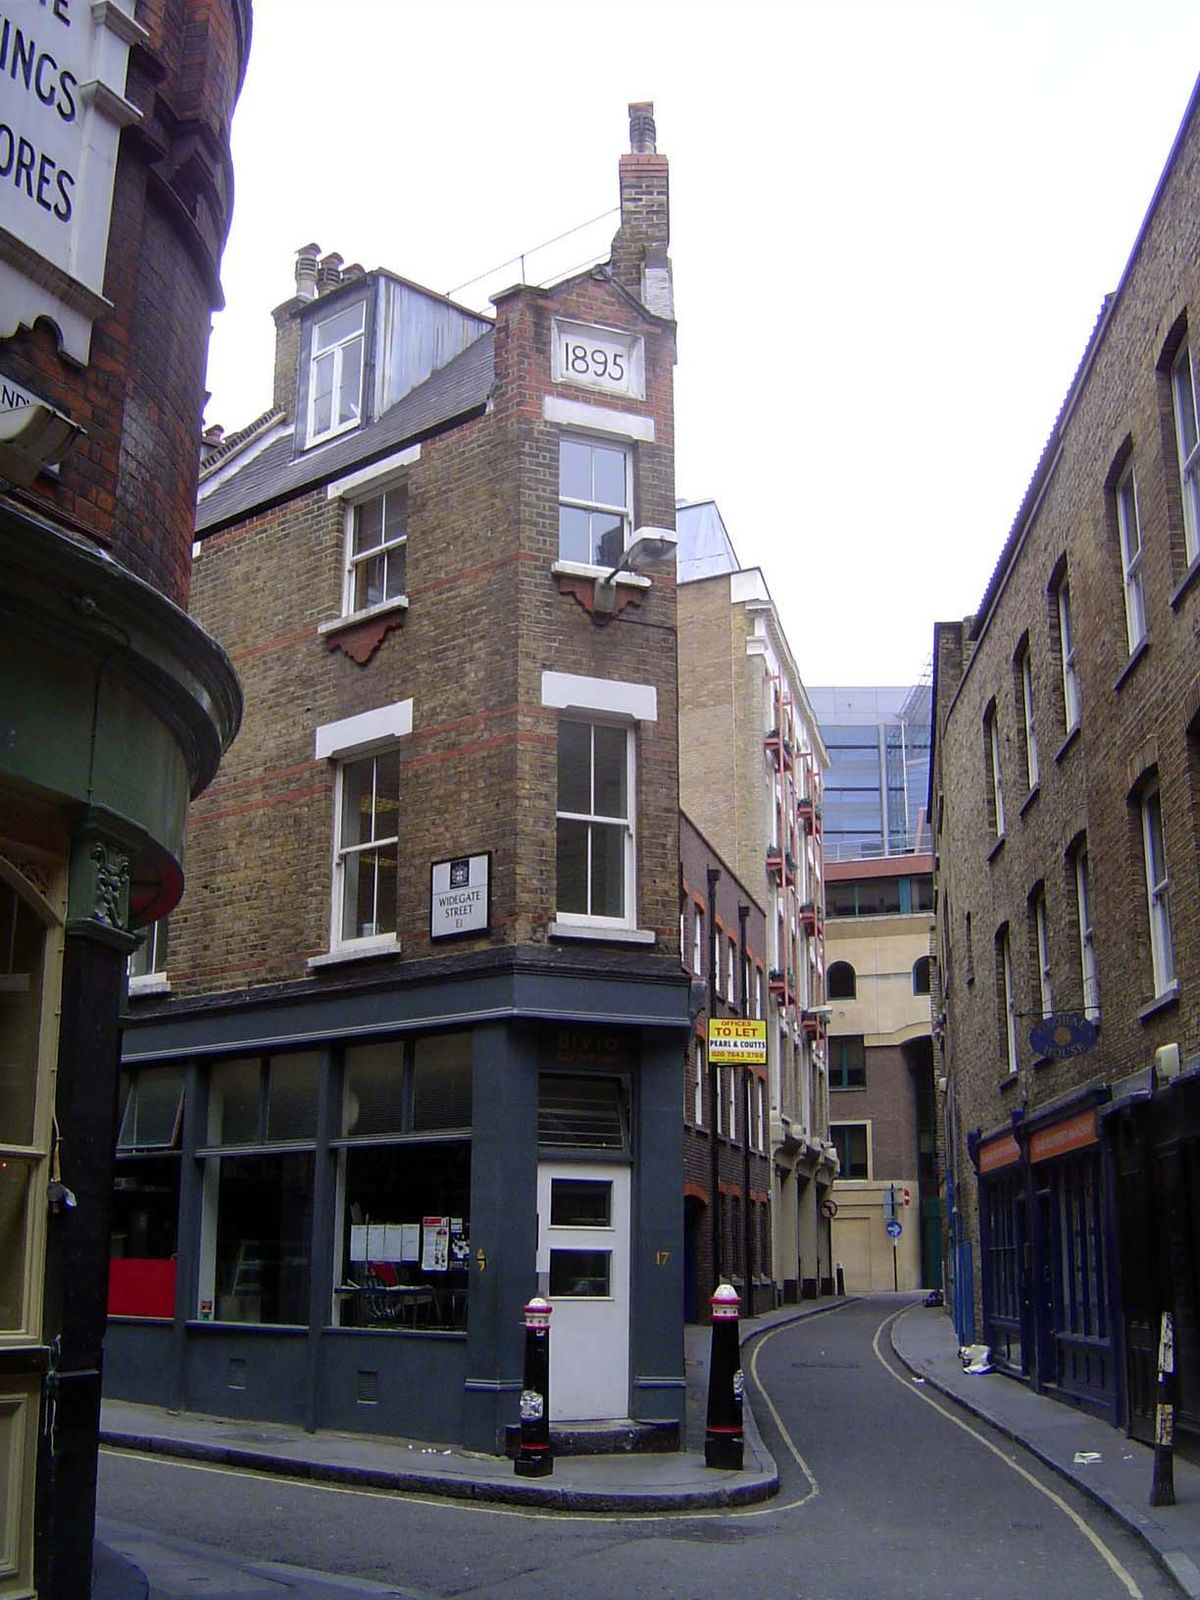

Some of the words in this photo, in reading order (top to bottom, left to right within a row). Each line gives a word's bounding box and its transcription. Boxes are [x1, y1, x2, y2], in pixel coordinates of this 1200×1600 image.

[0, 123, 76, 223] ORES
[565, 342, 624, 381] 1895
[439, 890, 481, 907] WIDEGATE
[445, 904, 473, 918] STREET
[715, 1027, 731, 1036] TO
[735, 1027, 758, 1037] LET
[740, 1041, 766, 1049] COUTTS
[655, 1250, 670, 1265] 17
